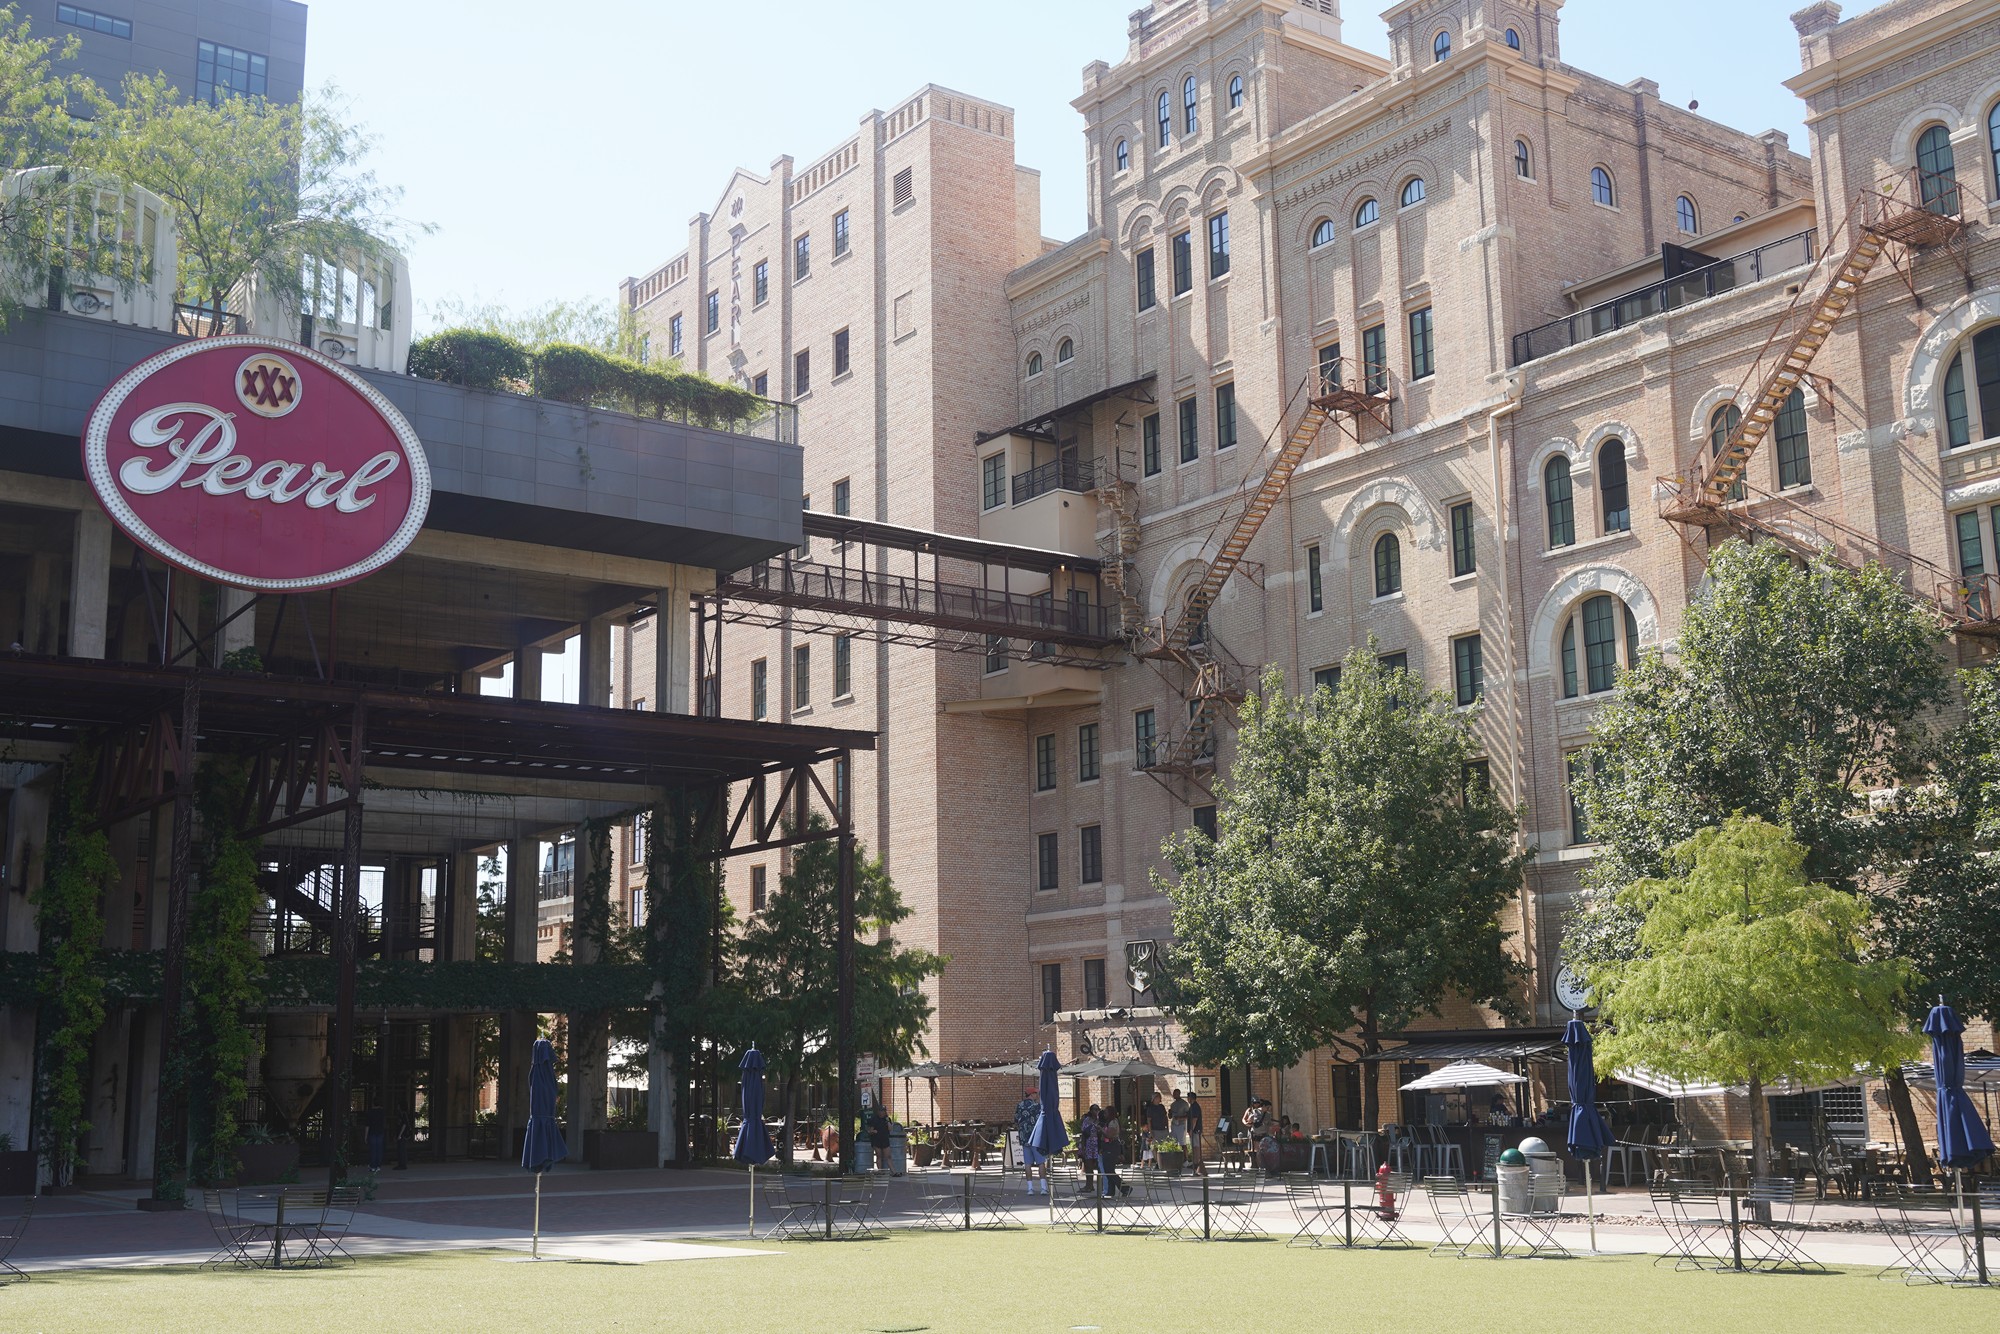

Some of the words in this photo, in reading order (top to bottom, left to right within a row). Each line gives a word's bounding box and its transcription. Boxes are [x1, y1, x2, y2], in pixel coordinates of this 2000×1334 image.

[731, 234, 742, 351] PEARL
[119, 402, 401, 514] Pearl
[1080, 1024, 1175, 1058] Sternewirth
